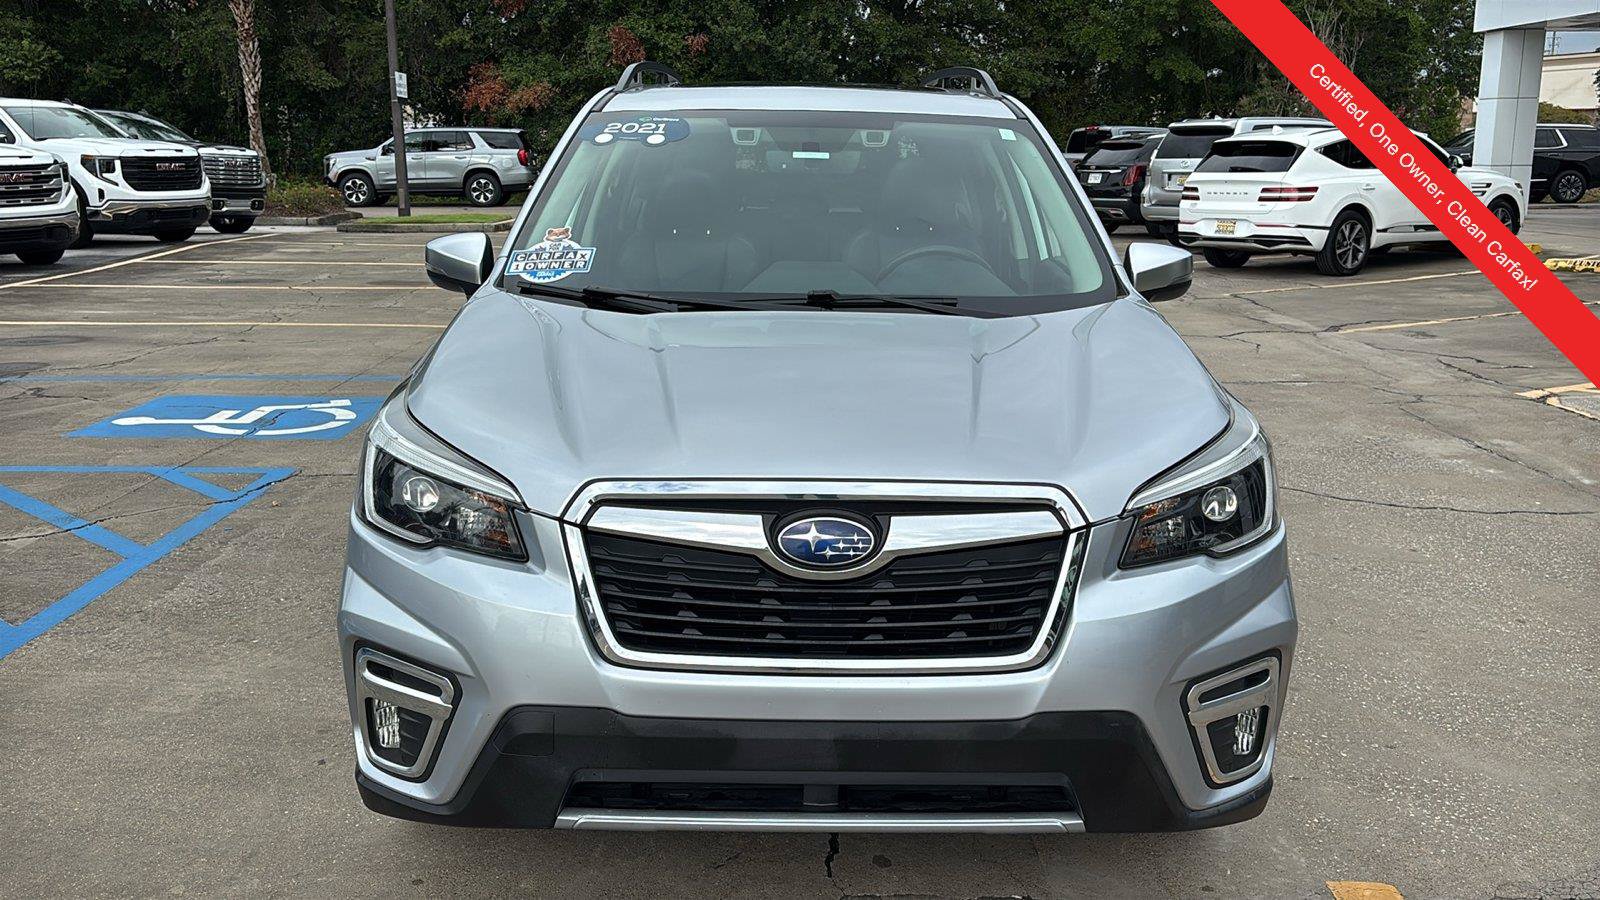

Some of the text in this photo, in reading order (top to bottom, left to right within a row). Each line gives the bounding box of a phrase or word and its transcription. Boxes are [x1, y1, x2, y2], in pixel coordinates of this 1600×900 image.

[603, 122, 666, 134] 2021
[516, 251, 588, 261] CARFAX
[525, 261, 586, 270] OWNER
